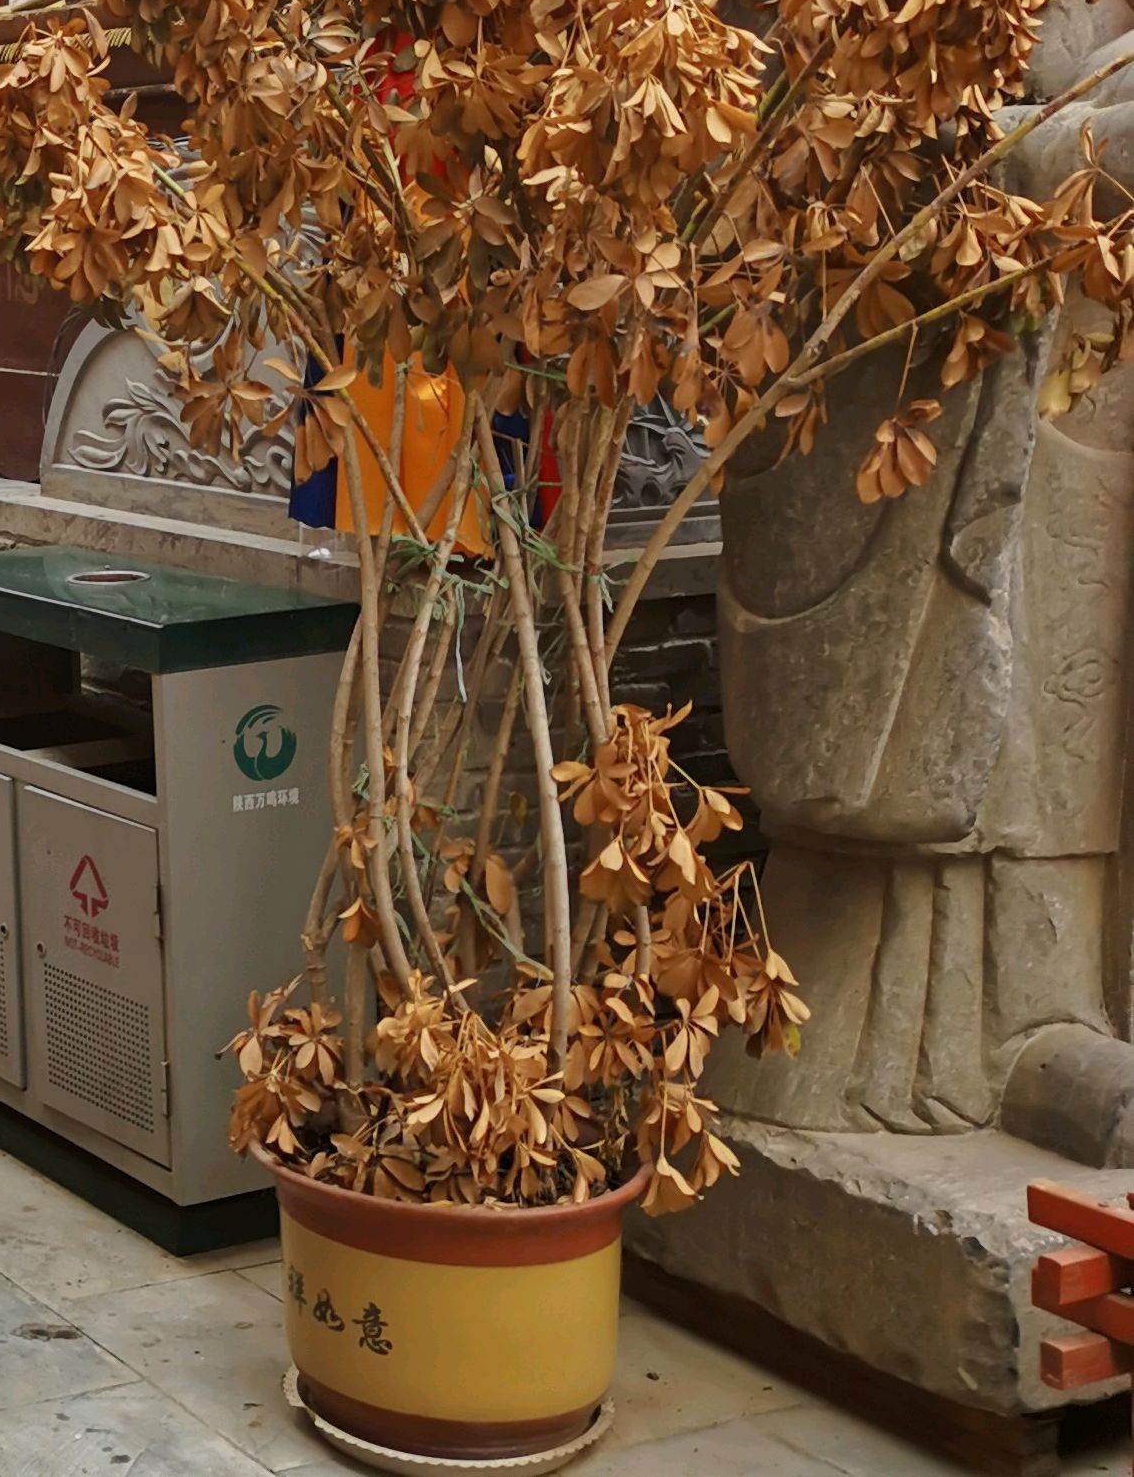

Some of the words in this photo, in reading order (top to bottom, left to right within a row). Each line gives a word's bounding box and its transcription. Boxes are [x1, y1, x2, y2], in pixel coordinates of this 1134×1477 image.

[64, 914, 120, 953] 不可回收垃圾
